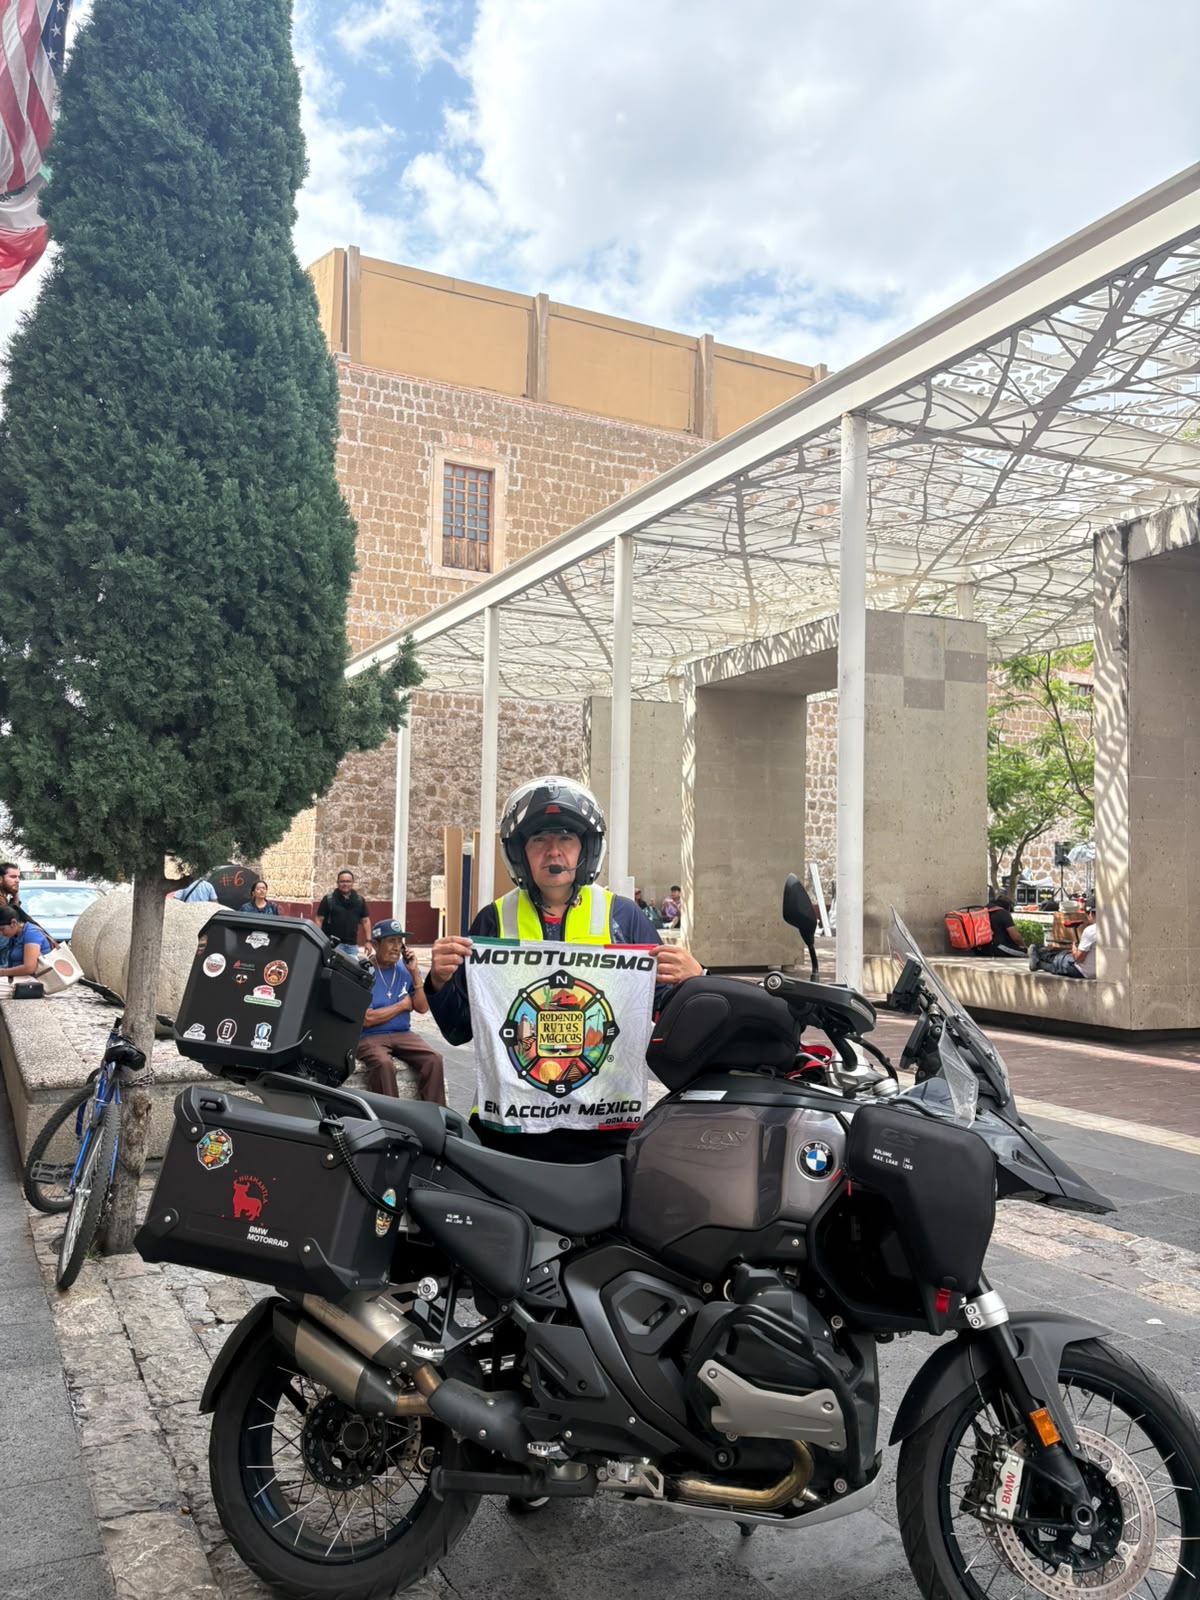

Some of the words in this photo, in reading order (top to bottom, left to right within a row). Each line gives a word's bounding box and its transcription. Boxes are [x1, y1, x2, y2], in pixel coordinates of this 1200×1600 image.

[219, 870, 245, 887] #6
[469, 948, 655, 972] MOTOTURISMO
[555, 975, 568, 984] N
[555, 1084, 566, 1093] S
[504, 1101, 572, 1119] ACCIÓN
[578, 1098, 642, 1116] MÉXICO
[238, 1175, 269, 1204] HUAMANTLA
[248, 1225, 269, 1236] BMW
[246, 1232, 289, 1248] MOTORRAD
[1001, 1470, 1017, 1505] BMW
